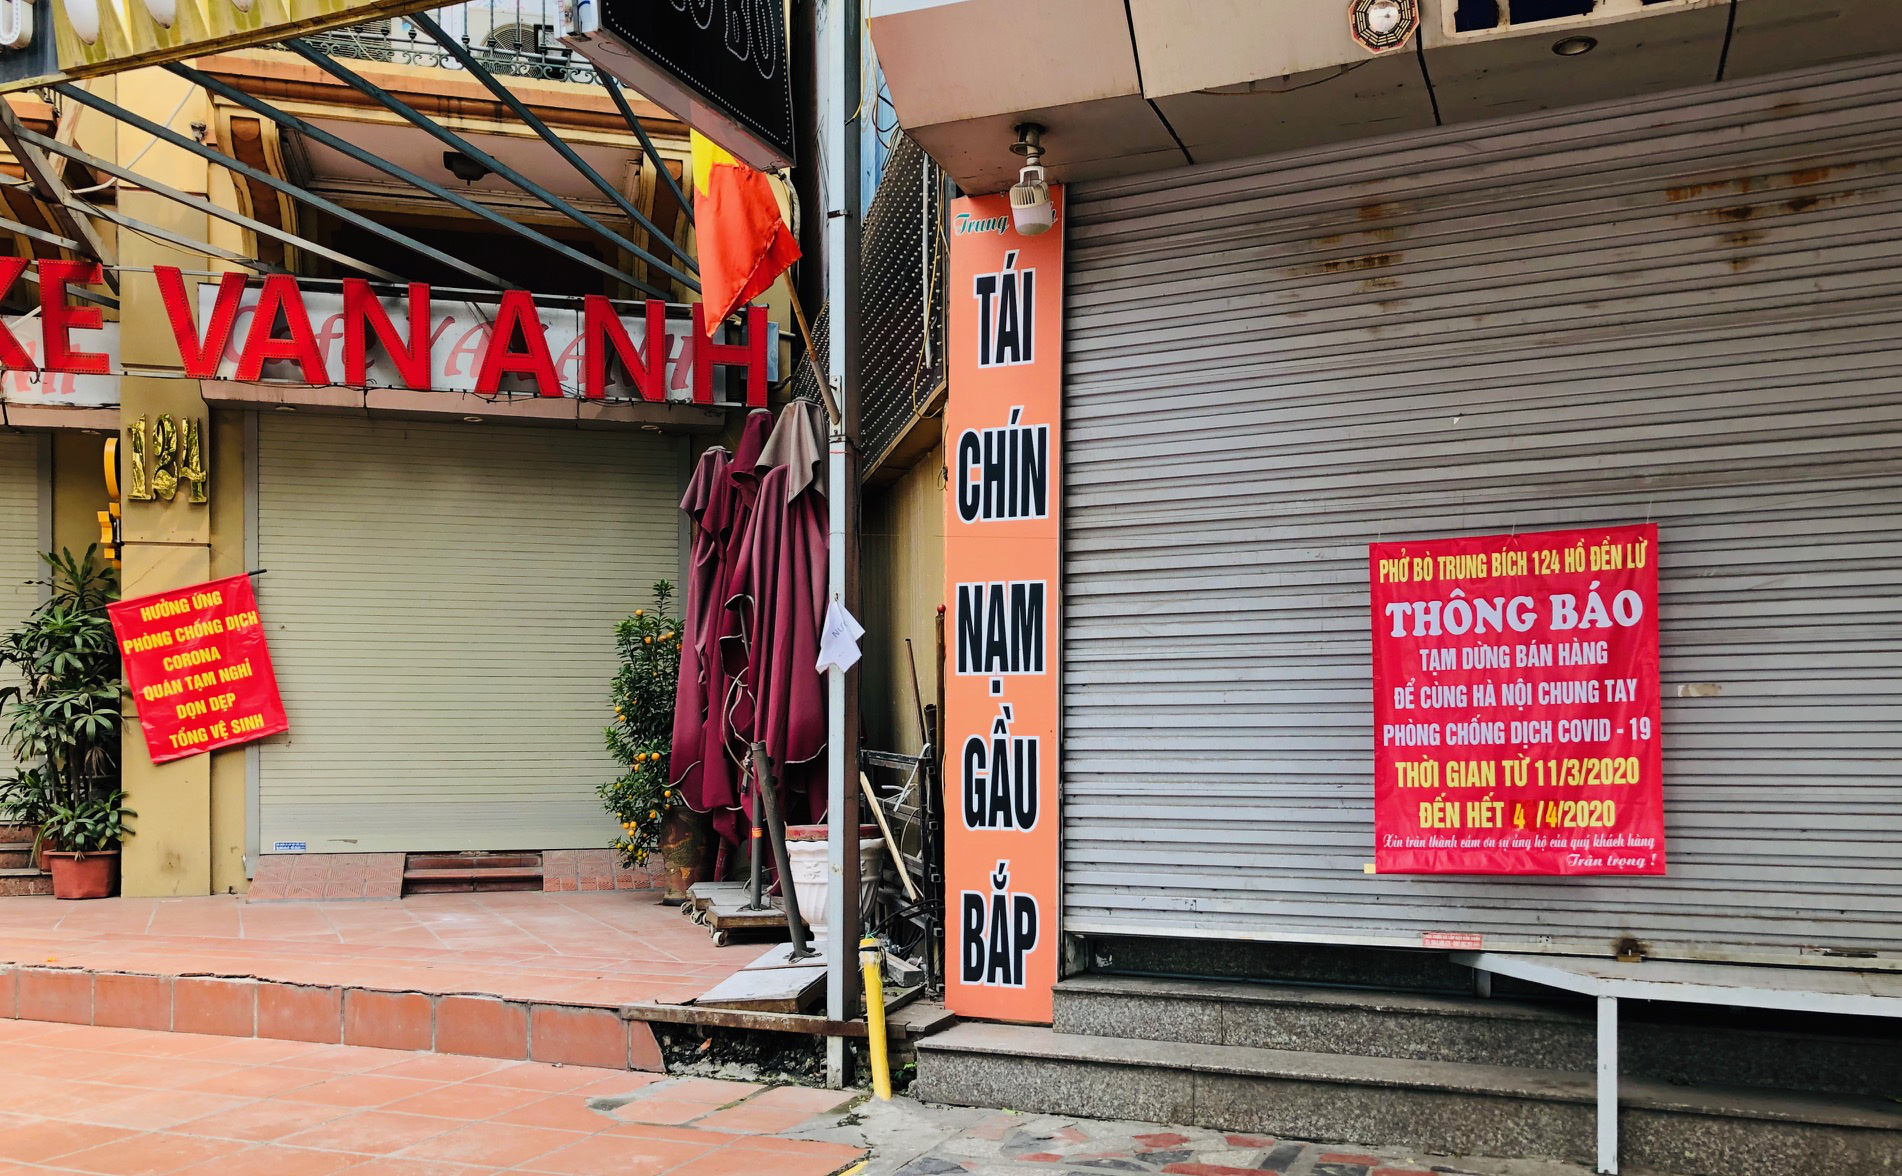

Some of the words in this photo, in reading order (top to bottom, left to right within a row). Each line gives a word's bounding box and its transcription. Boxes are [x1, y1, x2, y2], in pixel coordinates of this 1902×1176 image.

[955, 213, 1010, 236] Trung
[974, 249, 1036, 369] TÁI
[154, 264, 431, 391] VAN
[474, 289, 769, 408] ANH
[128, 413, 208, 504] 124
[956, 405, 1050, 524] CHÍN
[1379, 547, 1410, 584] PHỞ
[1413, 551, 1433, 582] BÒ
[1437, 553, 1487, 580] TRUNG
[1491, 547, 1528, 577] BÍCH
[1532, 549, 1560, 575] 124
[1564, 538, 1586, 573] HỒ
[1590, 536, 1622, 571] ĐỀN
[1627, 536, 1648, 569] LỪ
[140, 598, 190, 622] HƯỞNG
[192, 590, 223, 610] ỨNG
[1385, 588, 1537, 638] THÔNG
[1549, 580, 1643, 631] BÁO
[123, 632, 173, 654] PHÒNG
[175, 618, 224, 642] CHỐNG
[225, 610, 258, 632] DỊCH
[955, 579, 1047, 697] NẠM
[163, 646, 221, 672] CORONA
[1419, 648, 1457, 676] TẠM
[1462, 641, 1510, 670] DỪNG
[1515, 639, 1553, 668] BÁN
[1558, 637, 1608, 666] HÀNG
[143, 680, 183, 701] QUÁN
[184, 672, 216, 692] TẠM
[218, 657, 253, 682] NGHỈ
[1393, 677, 1416, 709] ĐỂ
[1420, 681, 1467, 708] CÙNG
[1472, 679, 1496, 707] HÀ
[1501, 678, 1533, 711] NỘI
[1537, 680, 1600, 706] CHUNG
[1604, 678, 1637, 703] TAY
[176, 699, 207, 719] DỌN
[208, 692, 236, 712] DẸP
[169, 727, 209, 749] TỔNG
[209, 721, 230, 740] VỆ
[231, 713, 264, 735] SINH
[1383, 718, 1440, 747] PHÒNG
[1445, 714, 1505, 746] CHỐNG
[1510, 719, 1552, 749] DỊCH
[1557, 718, 1611, 743] COVID
[1629, 716, 1651, 740] 19
[961, 703, 1040, 832] GẦU
[1395, 754, 1440, 788] THỜI
[1446, 760, 1495, 787] GIAN
[1501, 752, 1530, 787] TỪ
[1534, 756, 1640, 786] 11/3/2020
[1419, 792, 1461, 828] ĐẾN
[1466, 792, 1505, 828] HẾT
[1383, 833, 1403, 848] Xin
[1405, 836, 1426, 848] trân
[1428, 835, 1457, 848] thành
[1498, 837, 1510, 852] sự
[1512, 833, 1532, 851] ủng
[1534, 833, 1547, 852] hộ
[1549, 833, 1567, 848] của
[1570, 833, 1590, 850] quý
[1593, 832, 1624, 848] khách
[1627, 833, 1655, 850] hàng
[1566, 853, 1603, 867] Trân
[1607, 854, 1646, 869] trọng
[960, 859, 1040, 988] BẮP
